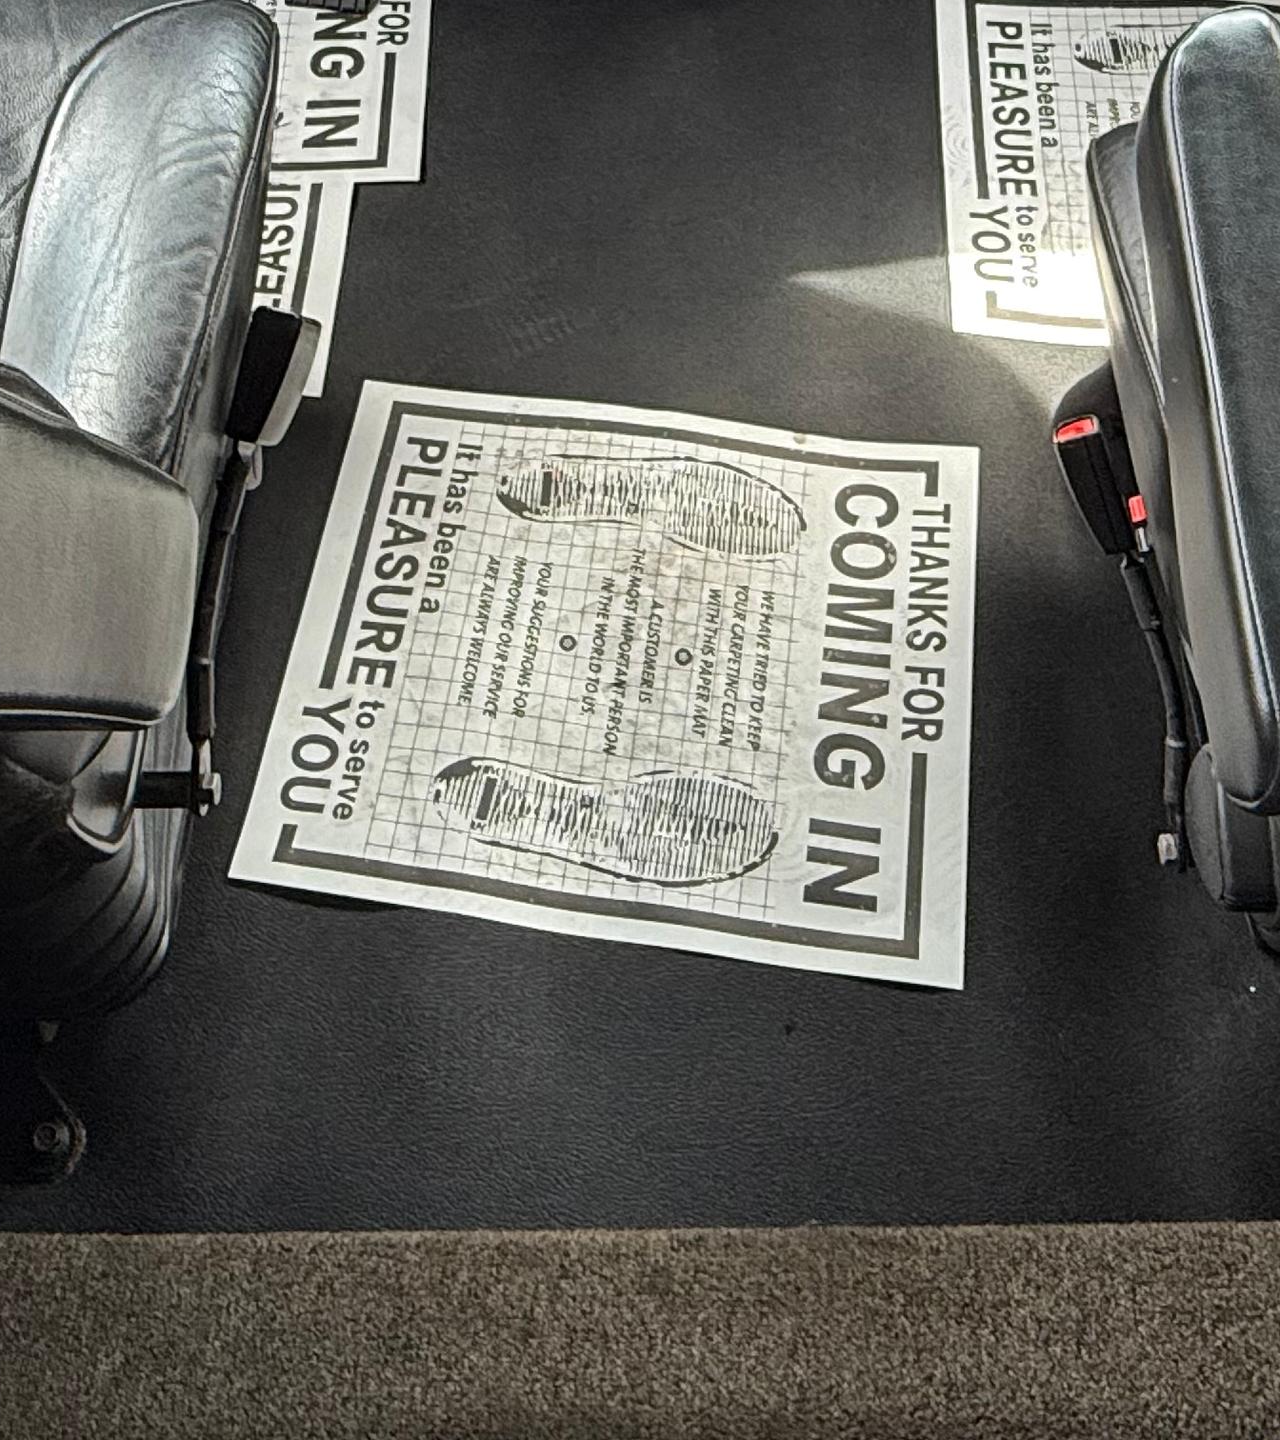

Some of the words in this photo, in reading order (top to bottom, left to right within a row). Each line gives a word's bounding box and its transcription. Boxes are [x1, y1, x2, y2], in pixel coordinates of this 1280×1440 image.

[376, 0, 412, 46] FOR
[1030, 23, 1054, 36] It
[1031, 43, 1056, 77] has
[302, 99, 362, 149] IN
[986, 20, 1039, 198] PLEASURE
[1035, 81, 1061, 131] been
[1041, 137, 1059, 149] a
[1015, 205, 1039, 227] to
[253, 183, 301, 308] EASU
[969, 205, 1015, 283] YOU
[1017, 232, 1039, 289] serve
[455, 442, 484, 462] It
[443, 468, 479, 515] has
[346, 436, 450, 689] PLEASURE
[425, 522, 468, 589] been
[484, 554, 501, 587] ARE
[630, 547, 647, 575] THE
[501, 555, 528, 632] IMPROVING
[535, 561, 554, 598] YOUR
[600, 576, 616, 593] IN
[624, 575, 643, 615] MOST
[905, 502, 952, 654] THANKS
[420, 596, 441, 615] a
[472, 582, 496, 635] ALWAYS
[596, 594, 613, 621] THE
[651, 597, 664, 611] A
[705, 588, 722, 627] WITH
[732, 584, 750, 623] YOUR
[761, 591, 775, 612] WE
[494, 632, 513, 663] OUR
[517, 598, 547, 688] SUGGESTIONS
[588, 621, 609, 674] WORLD
[640, 612, 663, 690] CUSTOMER
[701, 627, 719, 659] THIS
[756, 613, 773, 651] HAVE
[814, 483, 900, 791] COMING
[614, 614, 636, 699] IMPORTANT
[724, 623, 745, 701] CARPETING
[752, 651, 769, 692] TRIED
[482, 663, 507, 720] SERVICE
[585, 676, 600, 693] TO
[638, 690, 653, 705] IS
[696, 658, 715, 704] PAPER
[355, 699, 386, 730] to
[511, 688, 530, 719] FOR
[691, 704, 709, 739] MAT
[719, 702, 737, 748] CLEAN
[749, 695, 766, 714] TO
[901, 665, 946, 743] FOR
[603, 698, 625, 756] PERSON
[745, 716, 763, 752] KEEP
[280, 696, 353, 815] YOU
[332, 738, 370, 821] serve
[802, 817, 882, 913] IN
